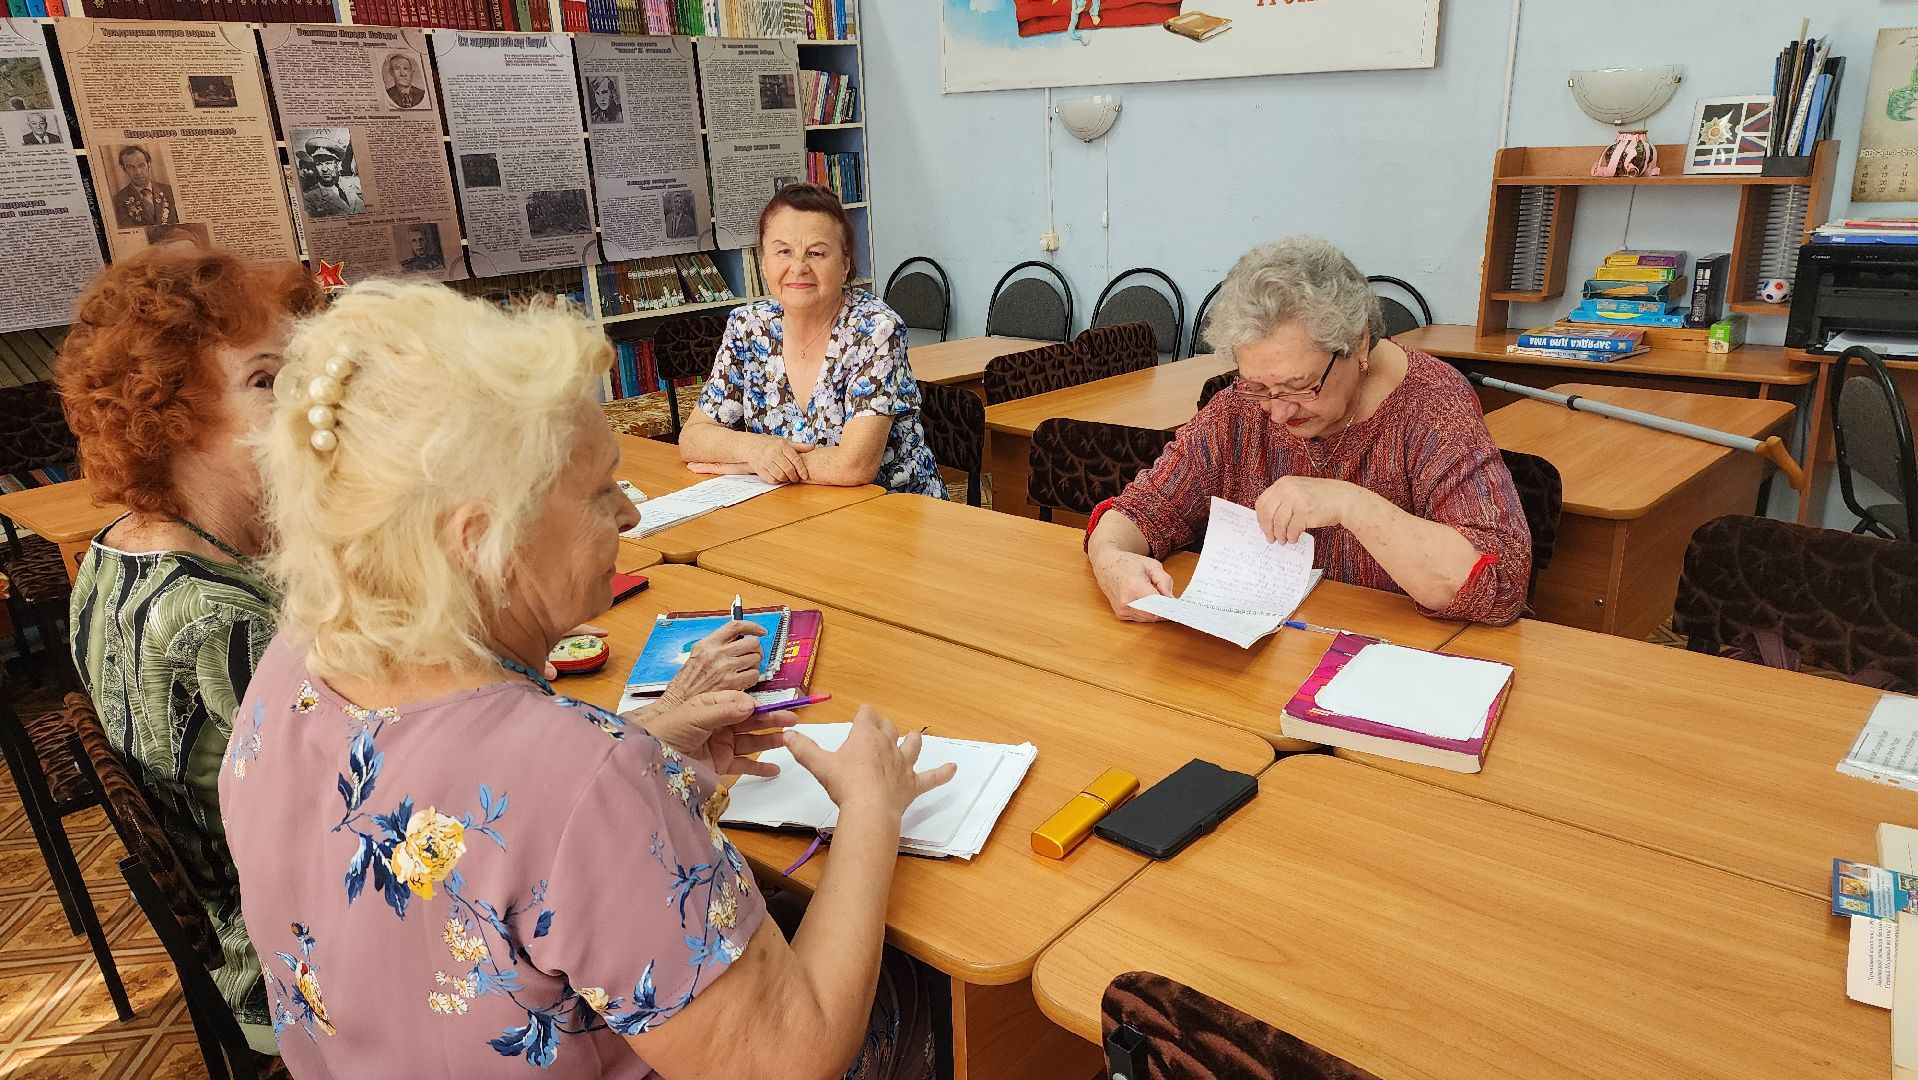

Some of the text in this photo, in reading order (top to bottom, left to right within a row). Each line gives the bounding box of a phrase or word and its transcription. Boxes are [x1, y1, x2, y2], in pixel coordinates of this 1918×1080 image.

[1529, 336, 1612, 350] ЗАРЯДКА ДЛЯ УМА
